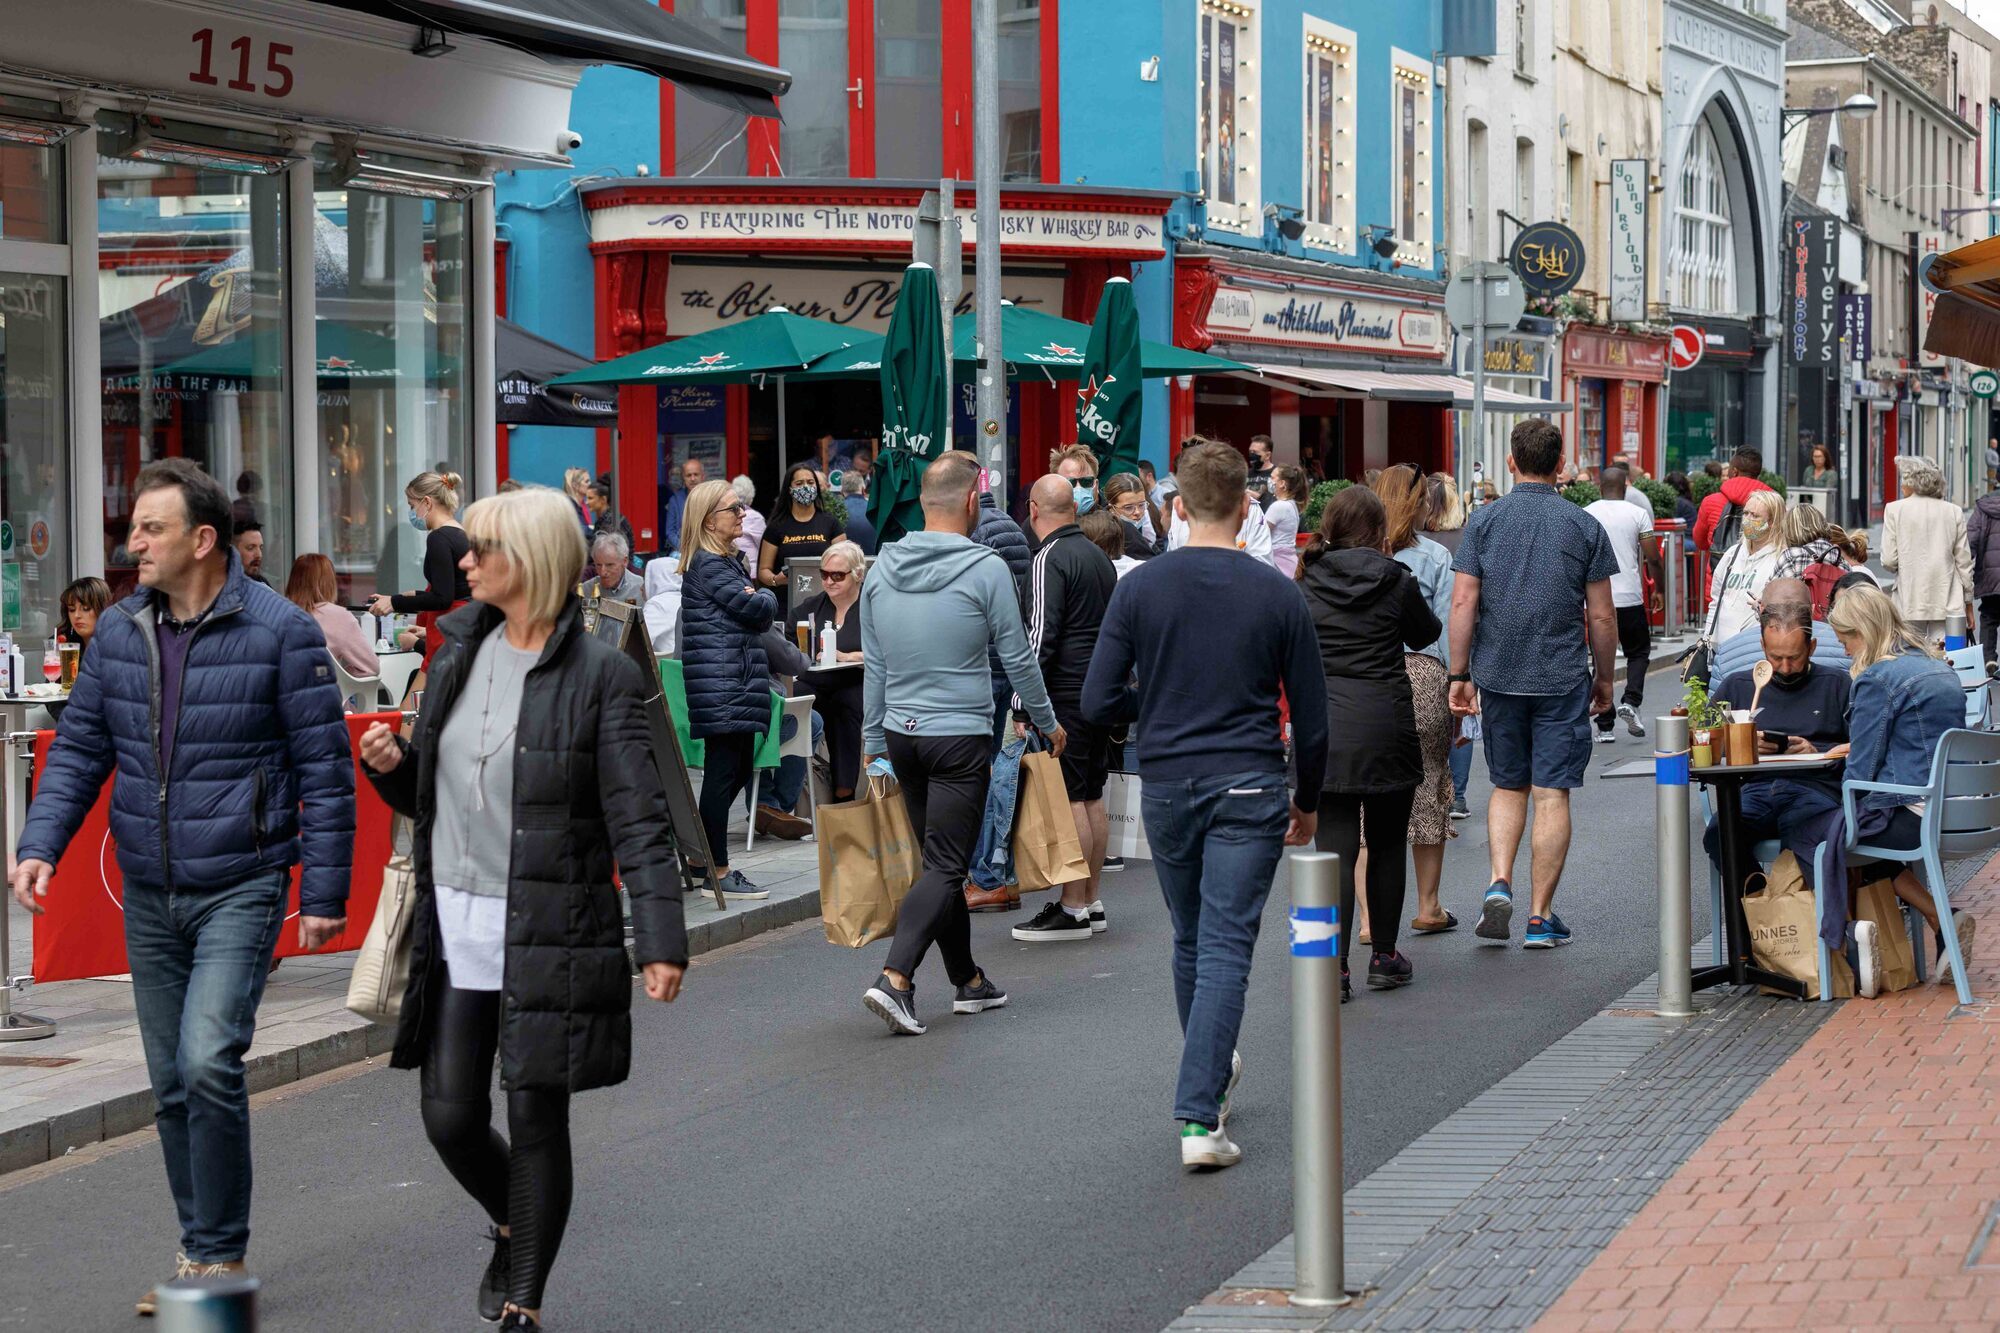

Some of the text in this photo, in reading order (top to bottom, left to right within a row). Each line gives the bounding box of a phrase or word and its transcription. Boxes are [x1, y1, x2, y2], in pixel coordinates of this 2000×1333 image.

[189, 28, 294, 98] 115
[700, 211, 805, 235] FEATURING
[813, 208, 859, 230] THE
[1041, 217, 1103, 241] WHISKEY
[1107, 220, 1129, 237] BAR
[681, 290, 715, 310] the
[1794, 233, 1808, 362] INTERSPORT
[1820, 220, 1836, 362] Elverys
[1845, 304, 1853, 336] GALA
[1857, 296, 1865, 359] LIGHTING
[181, 376, 210, 391] THE
[217, 378, 248, 393] BAR
[1976, 381, 1992, 391] 126
[579, 397, 613, 412] GUINNESS
[1750, 924, 1798, 941] UNNES
